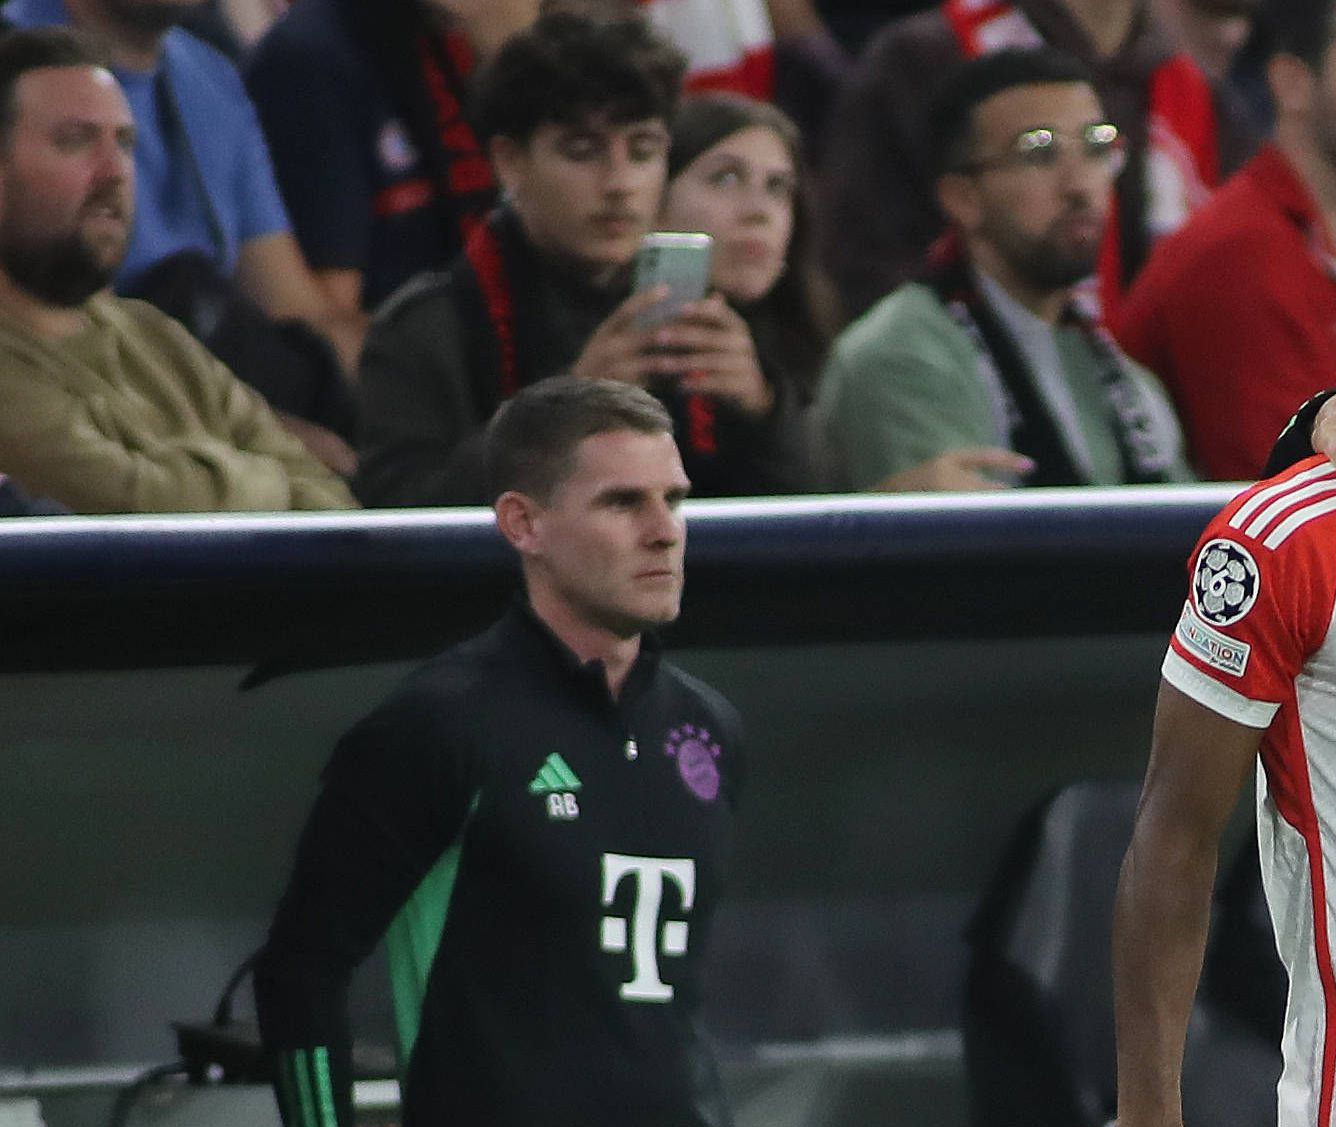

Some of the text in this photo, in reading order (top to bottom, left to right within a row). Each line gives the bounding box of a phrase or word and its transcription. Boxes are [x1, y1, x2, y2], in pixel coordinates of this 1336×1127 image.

[1208, 568, 1230, 598] 6
[547, 792, 580, 819] AB
[601, 852, 697, 1003] T
